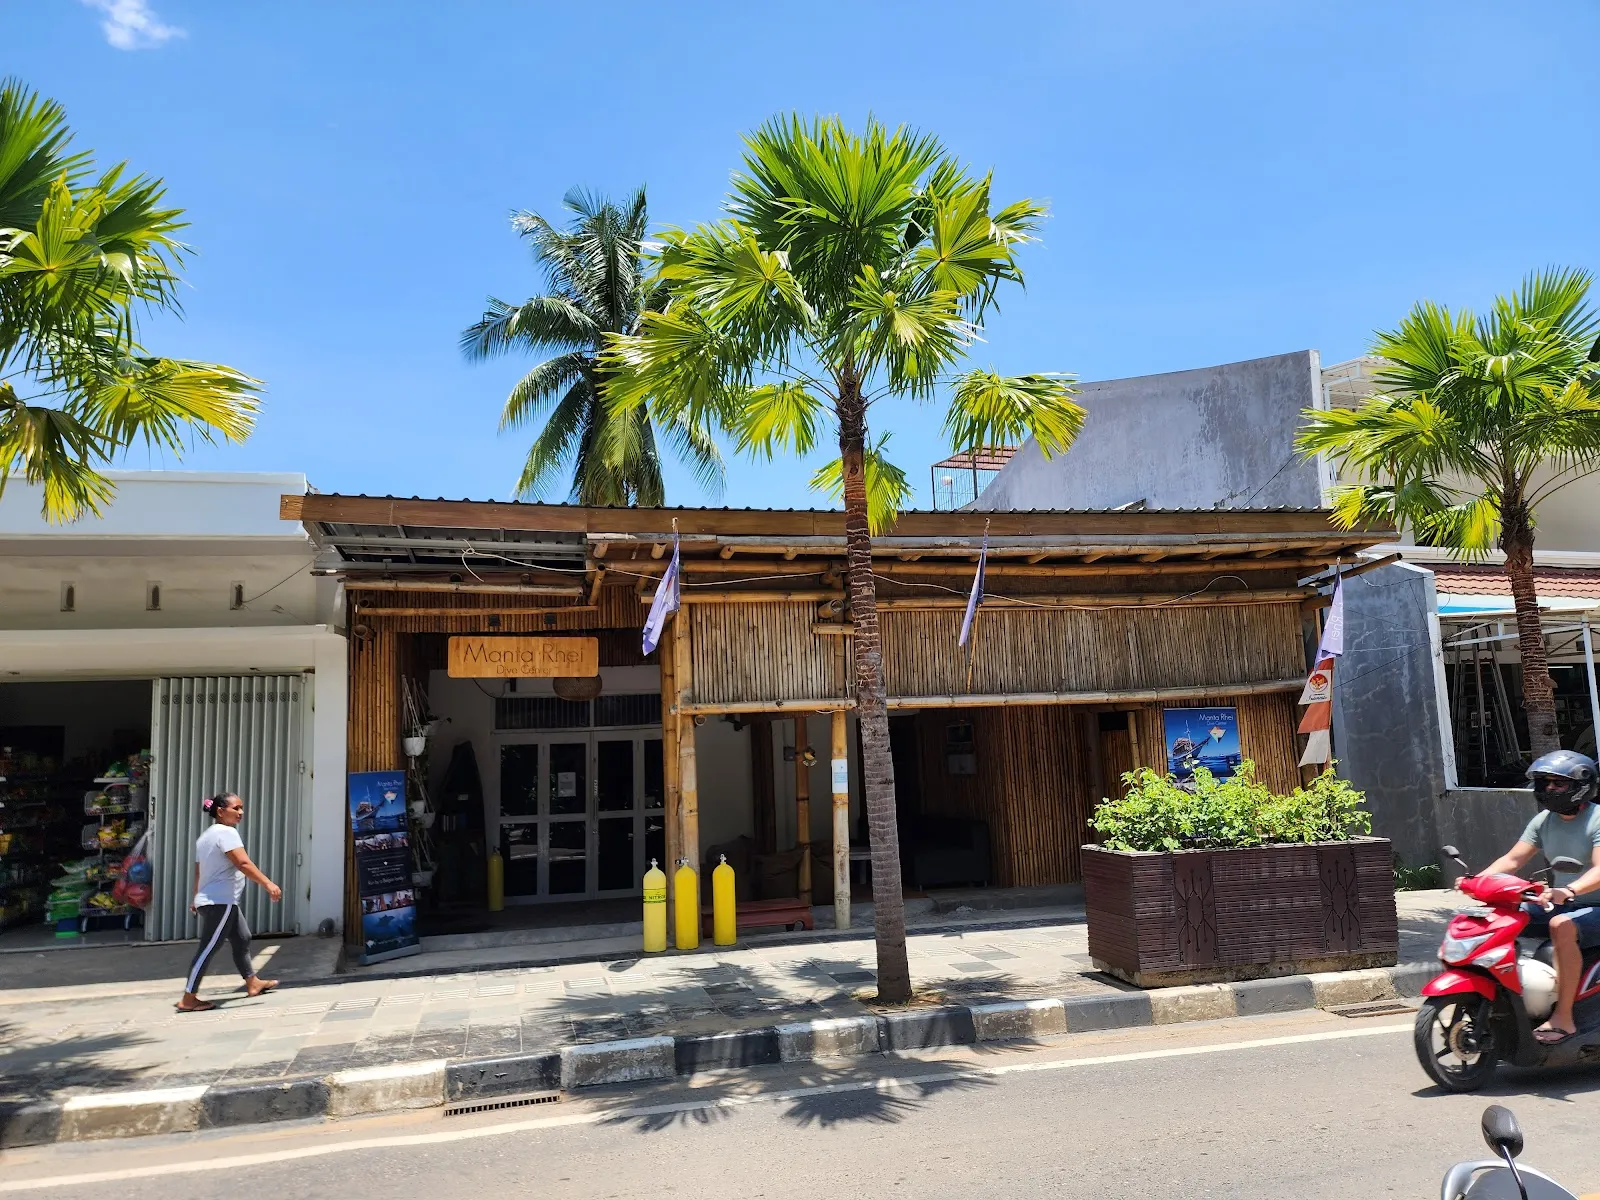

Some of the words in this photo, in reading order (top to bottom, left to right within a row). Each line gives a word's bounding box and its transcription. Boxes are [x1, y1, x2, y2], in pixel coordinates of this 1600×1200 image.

[463, 642, 534, 663] Manta
[542, 642, 584, 663] Rhei
[496, 664, 518, 675] Dive
[1198, 713, 1220, 721] Manta
[1220, 712, 1234, 721] Rhei
